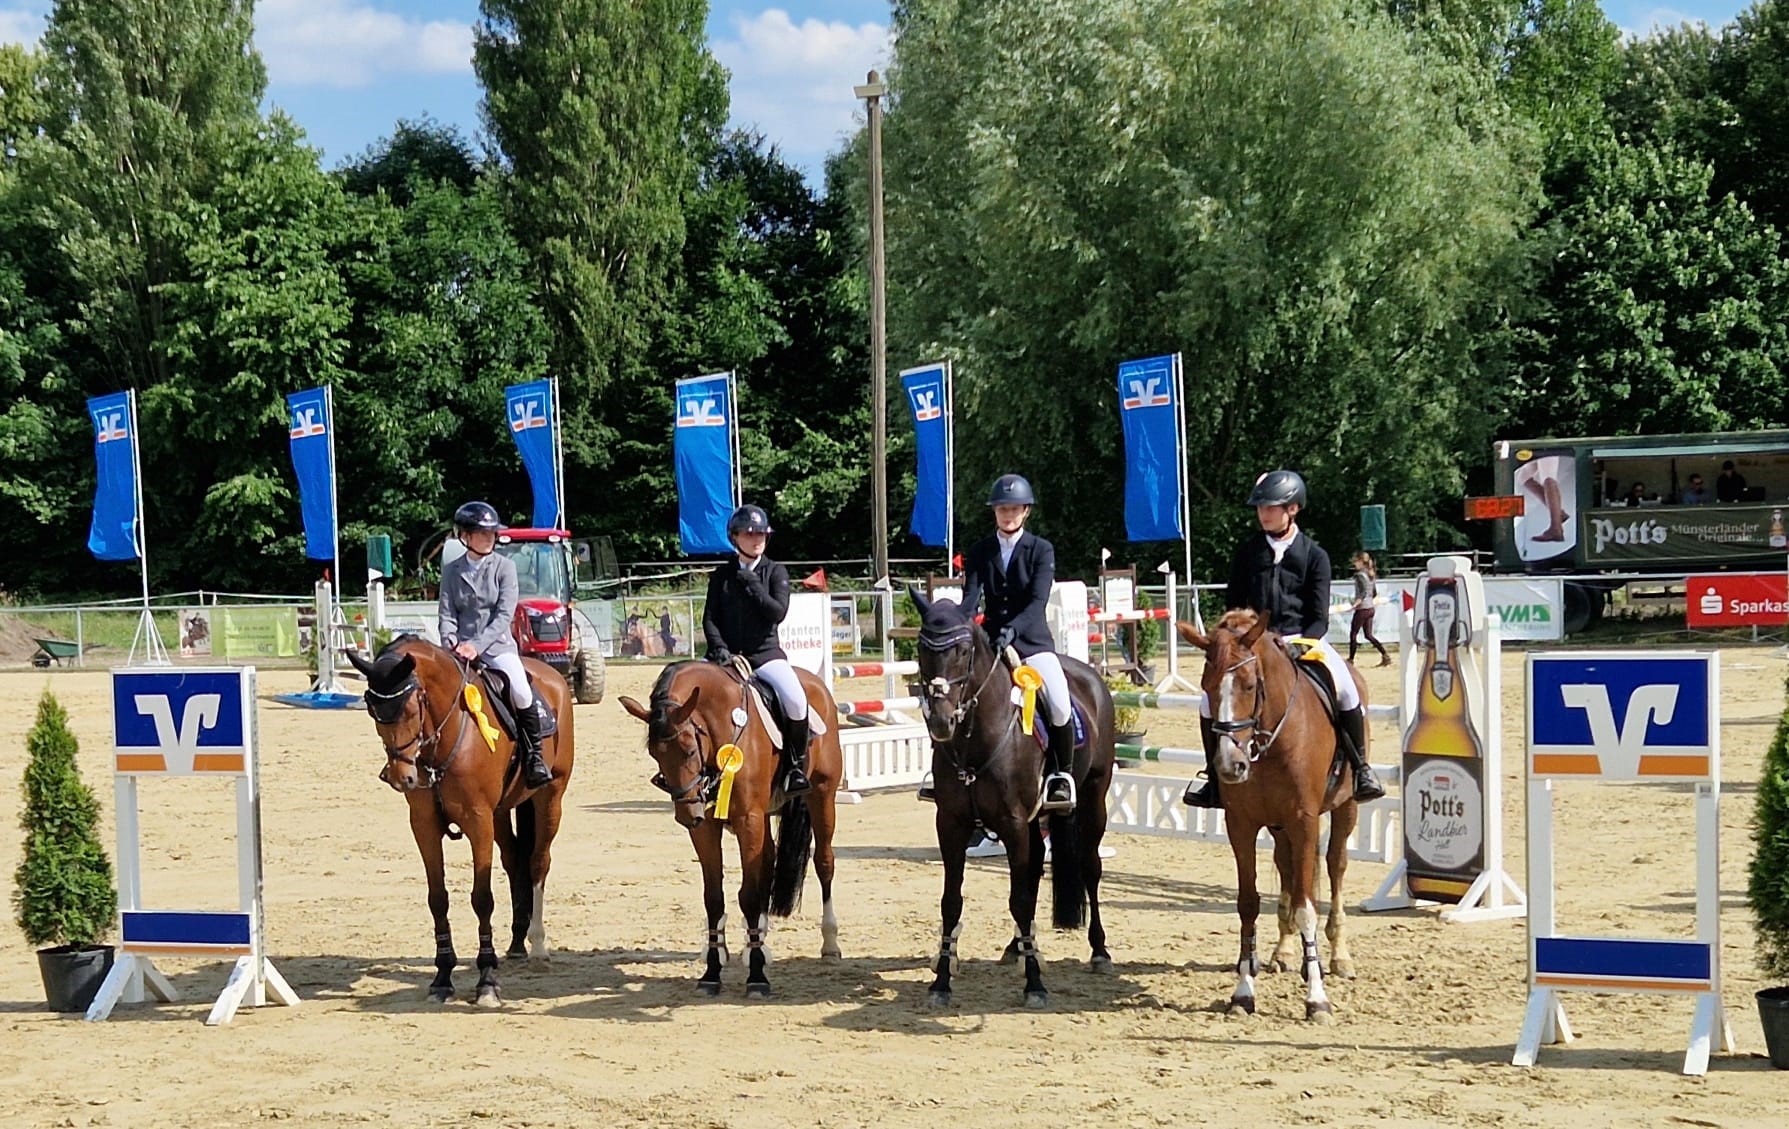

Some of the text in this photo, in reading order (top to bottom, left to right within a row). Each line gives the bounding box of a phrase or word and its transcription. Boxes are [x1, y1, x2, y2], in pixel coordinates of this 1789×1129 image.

[1591, 519, 1668, 553] Pott's
[1672, 523, 1760, 535] Münsterländer
[1419, 789, 1464, 821] Pott's
